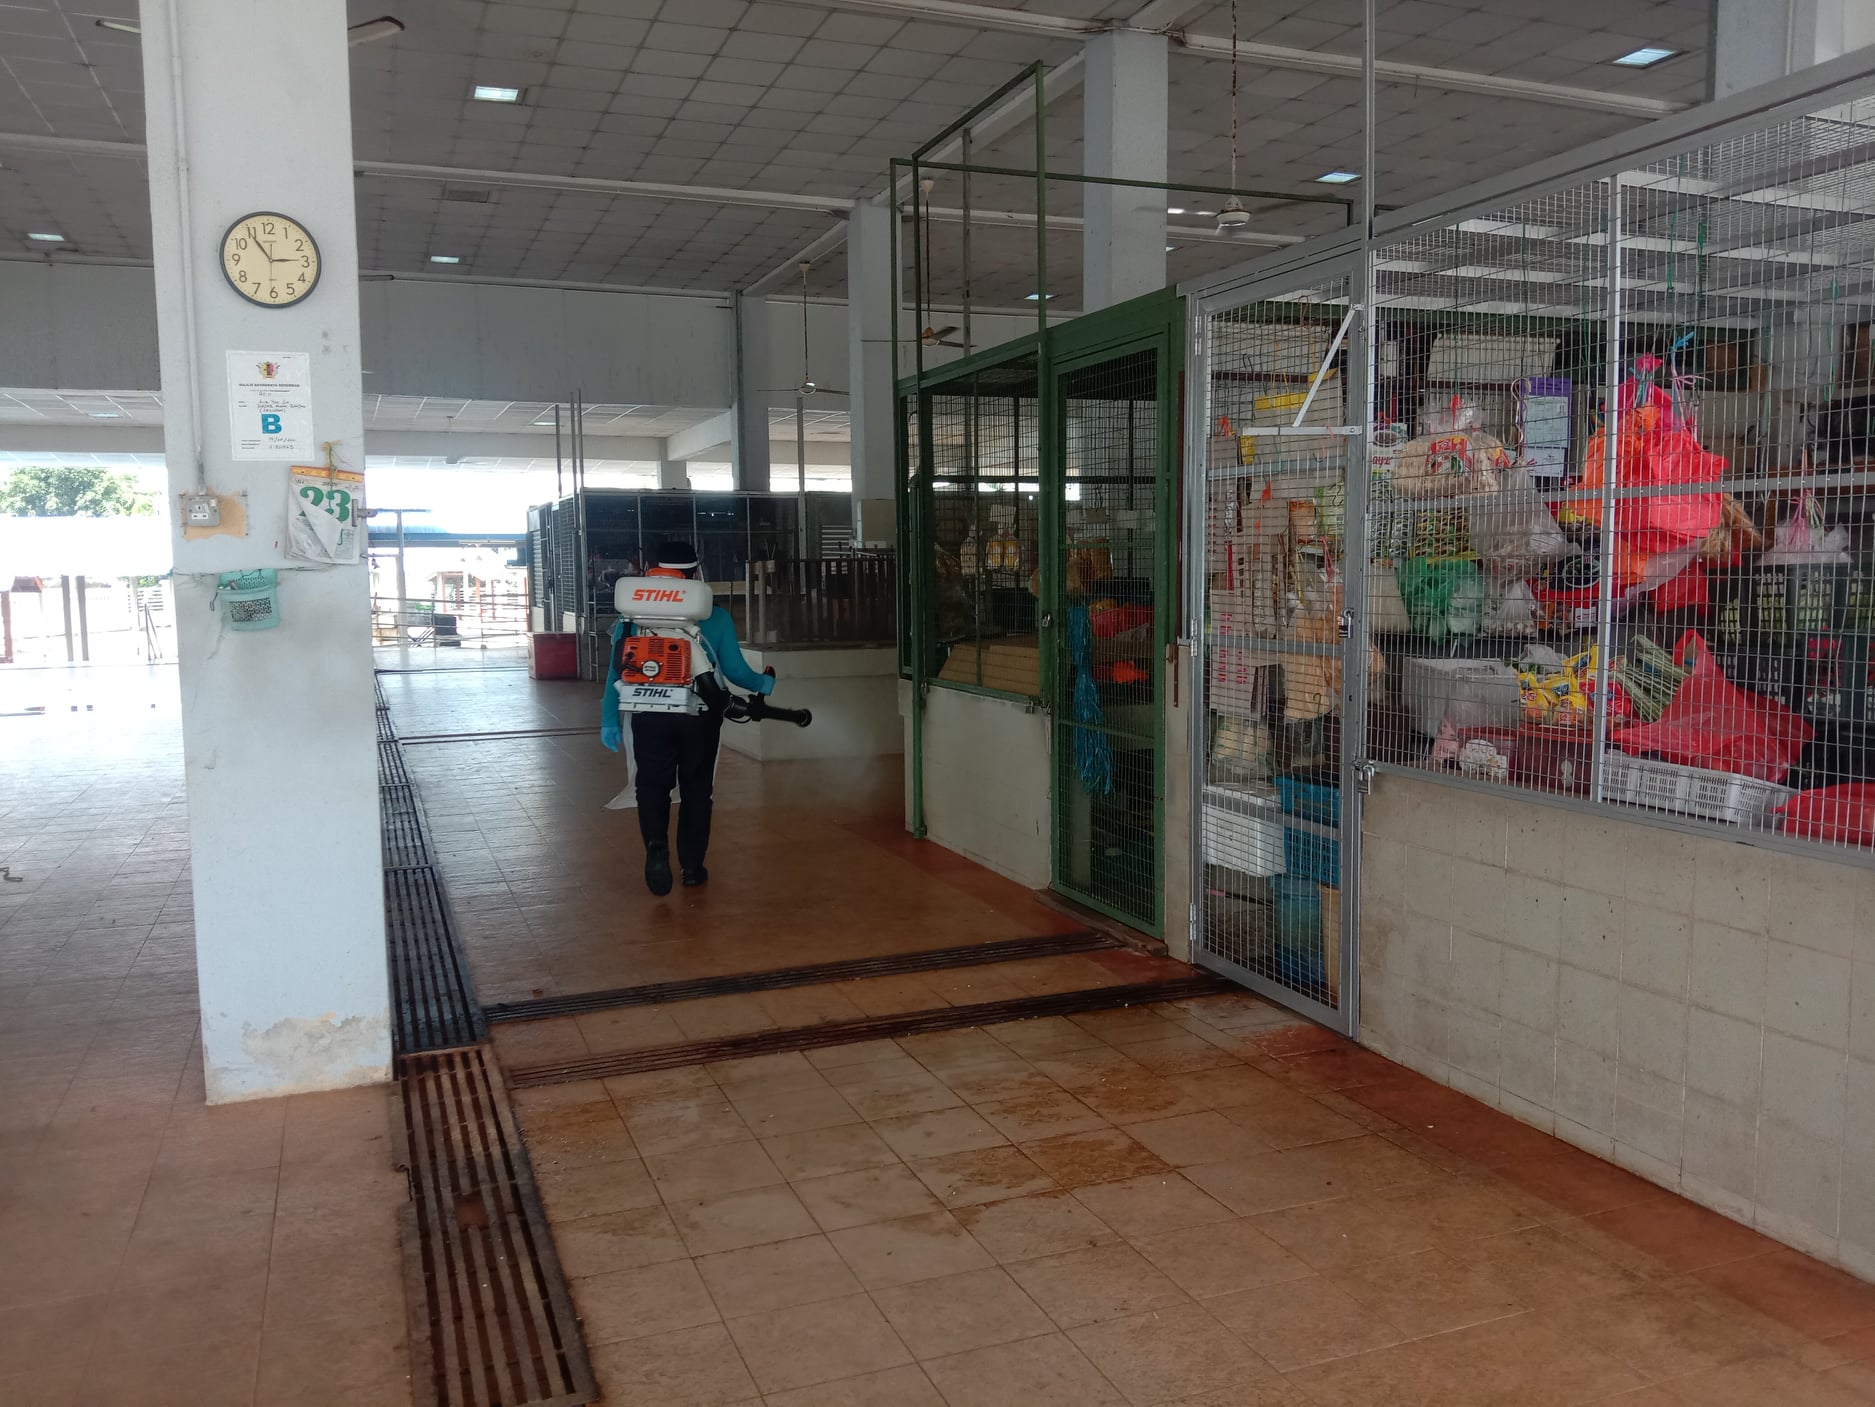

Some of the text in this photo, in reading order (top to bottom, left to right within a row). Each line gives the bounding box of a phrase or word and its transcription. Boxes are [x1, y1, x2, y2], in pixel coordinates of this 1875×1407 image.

[246, 226, 257, 239] 11
[261, 222, 276, 235] 12
[283, 226, 288, 240] 1
[234, 238, 248, 250] 10
[294, 238, 305, 251] 2
[231, 253, 241, 266] 9
[300, 255, 310, 268] 3
[238, 270, 248, 283] 8
[297, 272, 306, 283] 4
[252, 282, 261, 295] 7
[269, 286, 279, 299] 6
[286, 282, 295, 295] 5
[261, 413, 282, 434] B
[298, 486, 351, 522] 23
[632, 589, 684, 602] STIHL
[632, 687, 672, 698] STIHL
